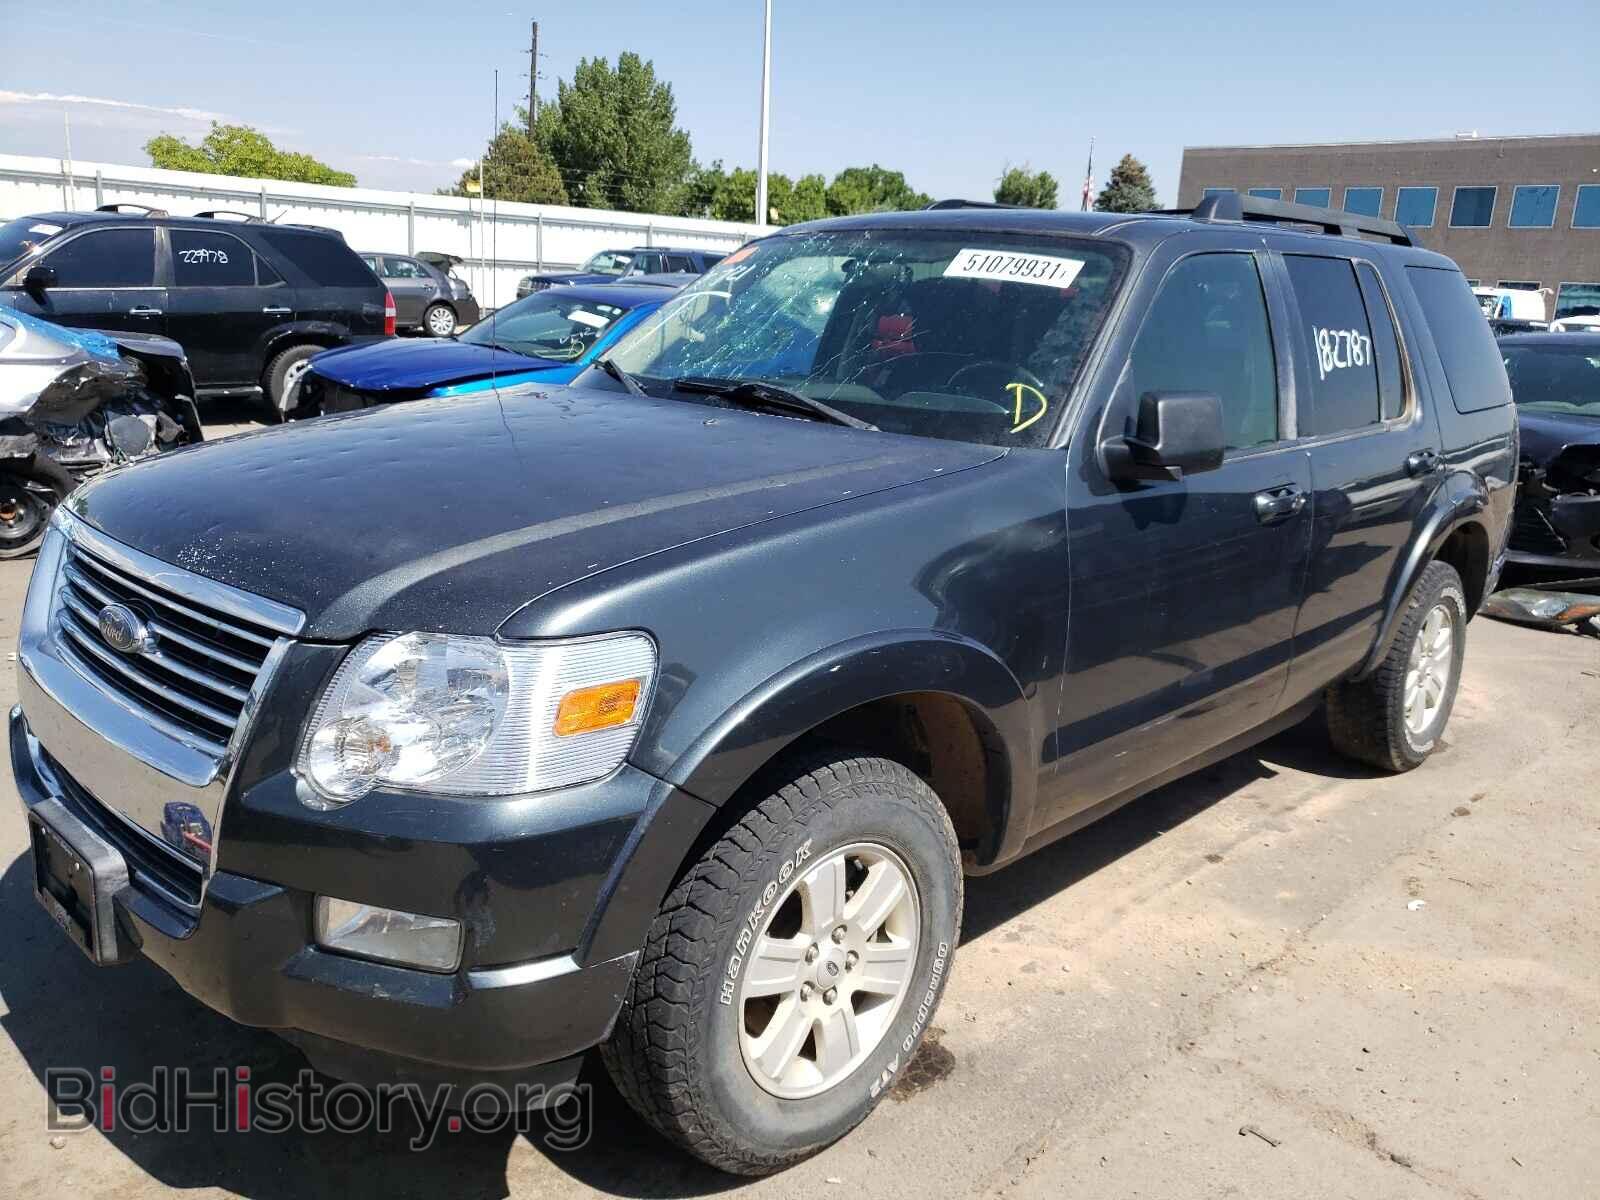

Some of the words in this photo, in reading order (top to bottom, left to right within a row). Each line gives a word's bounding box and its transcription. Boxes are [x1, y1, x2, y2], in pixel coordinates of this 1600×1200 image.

[963, 254, 1061, 280] 51079931
[1311, 324, 1371, 381] 182787
[1005, 382, 1048, 434] D
